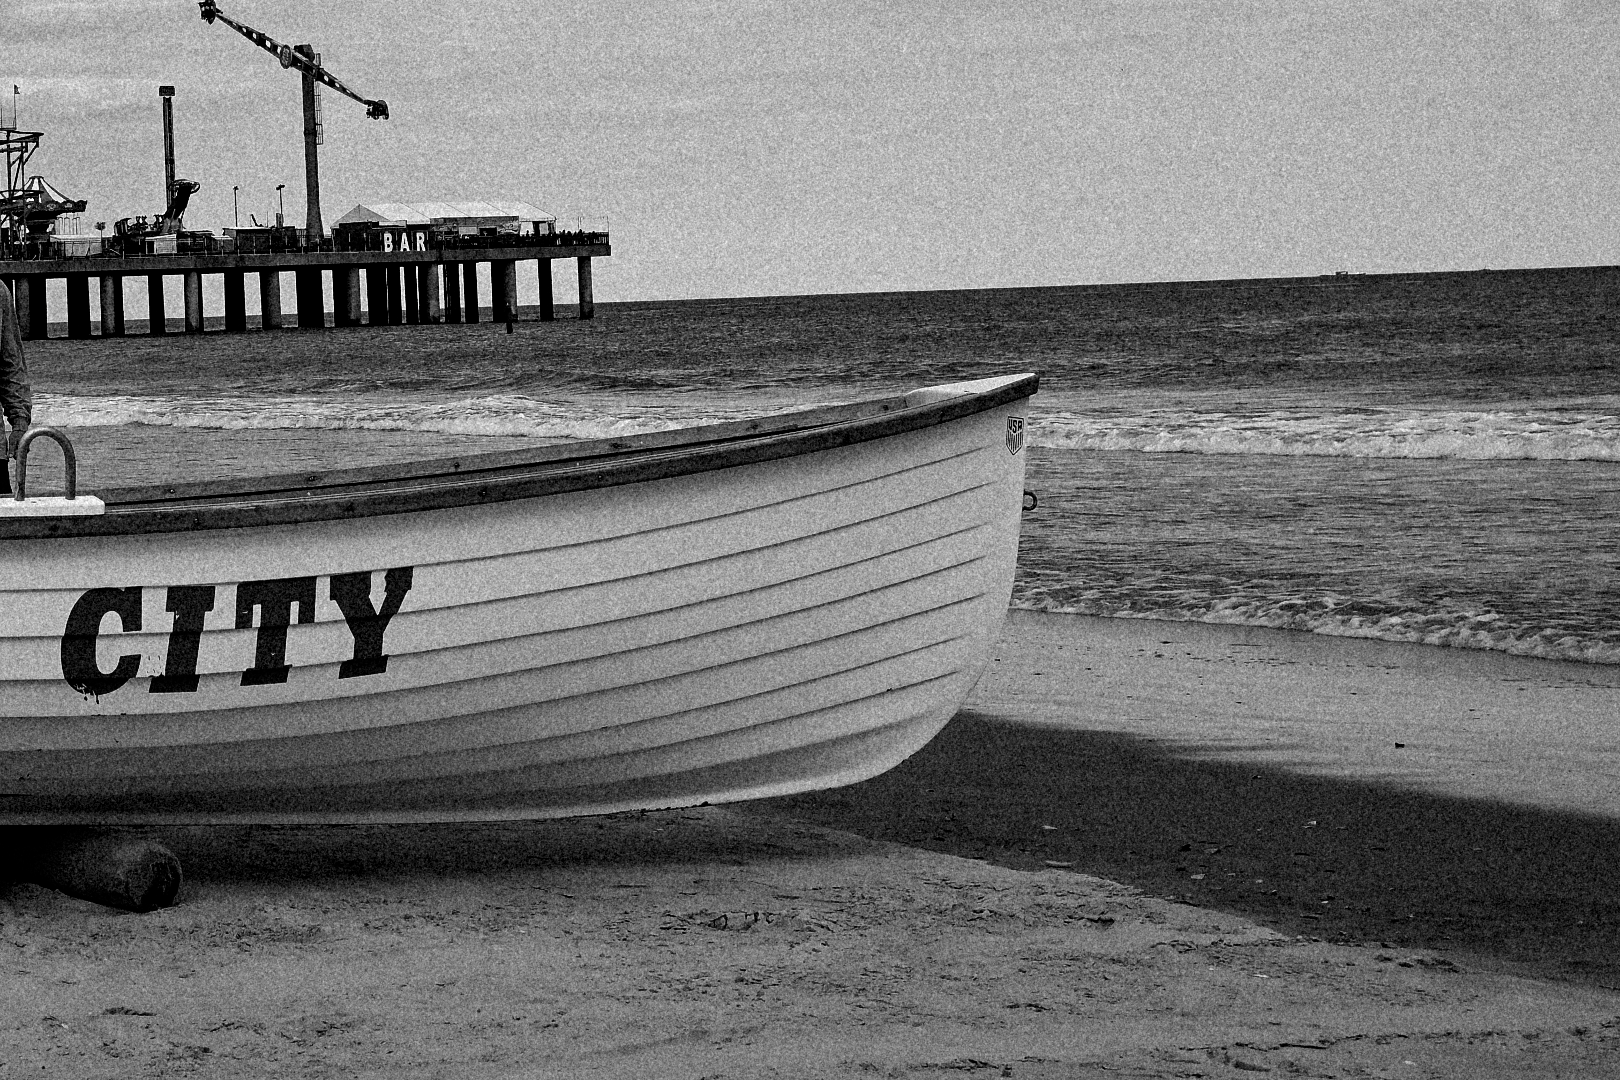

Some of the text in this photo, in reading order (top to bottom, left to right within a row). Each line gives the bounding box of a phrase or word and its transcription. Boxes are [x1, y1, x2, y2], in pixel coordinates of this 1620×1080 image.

[383, 232, 426, 252] BAR
[1008, 419, 1023, 433] USA
[61, 565, 415, 698] CITY
